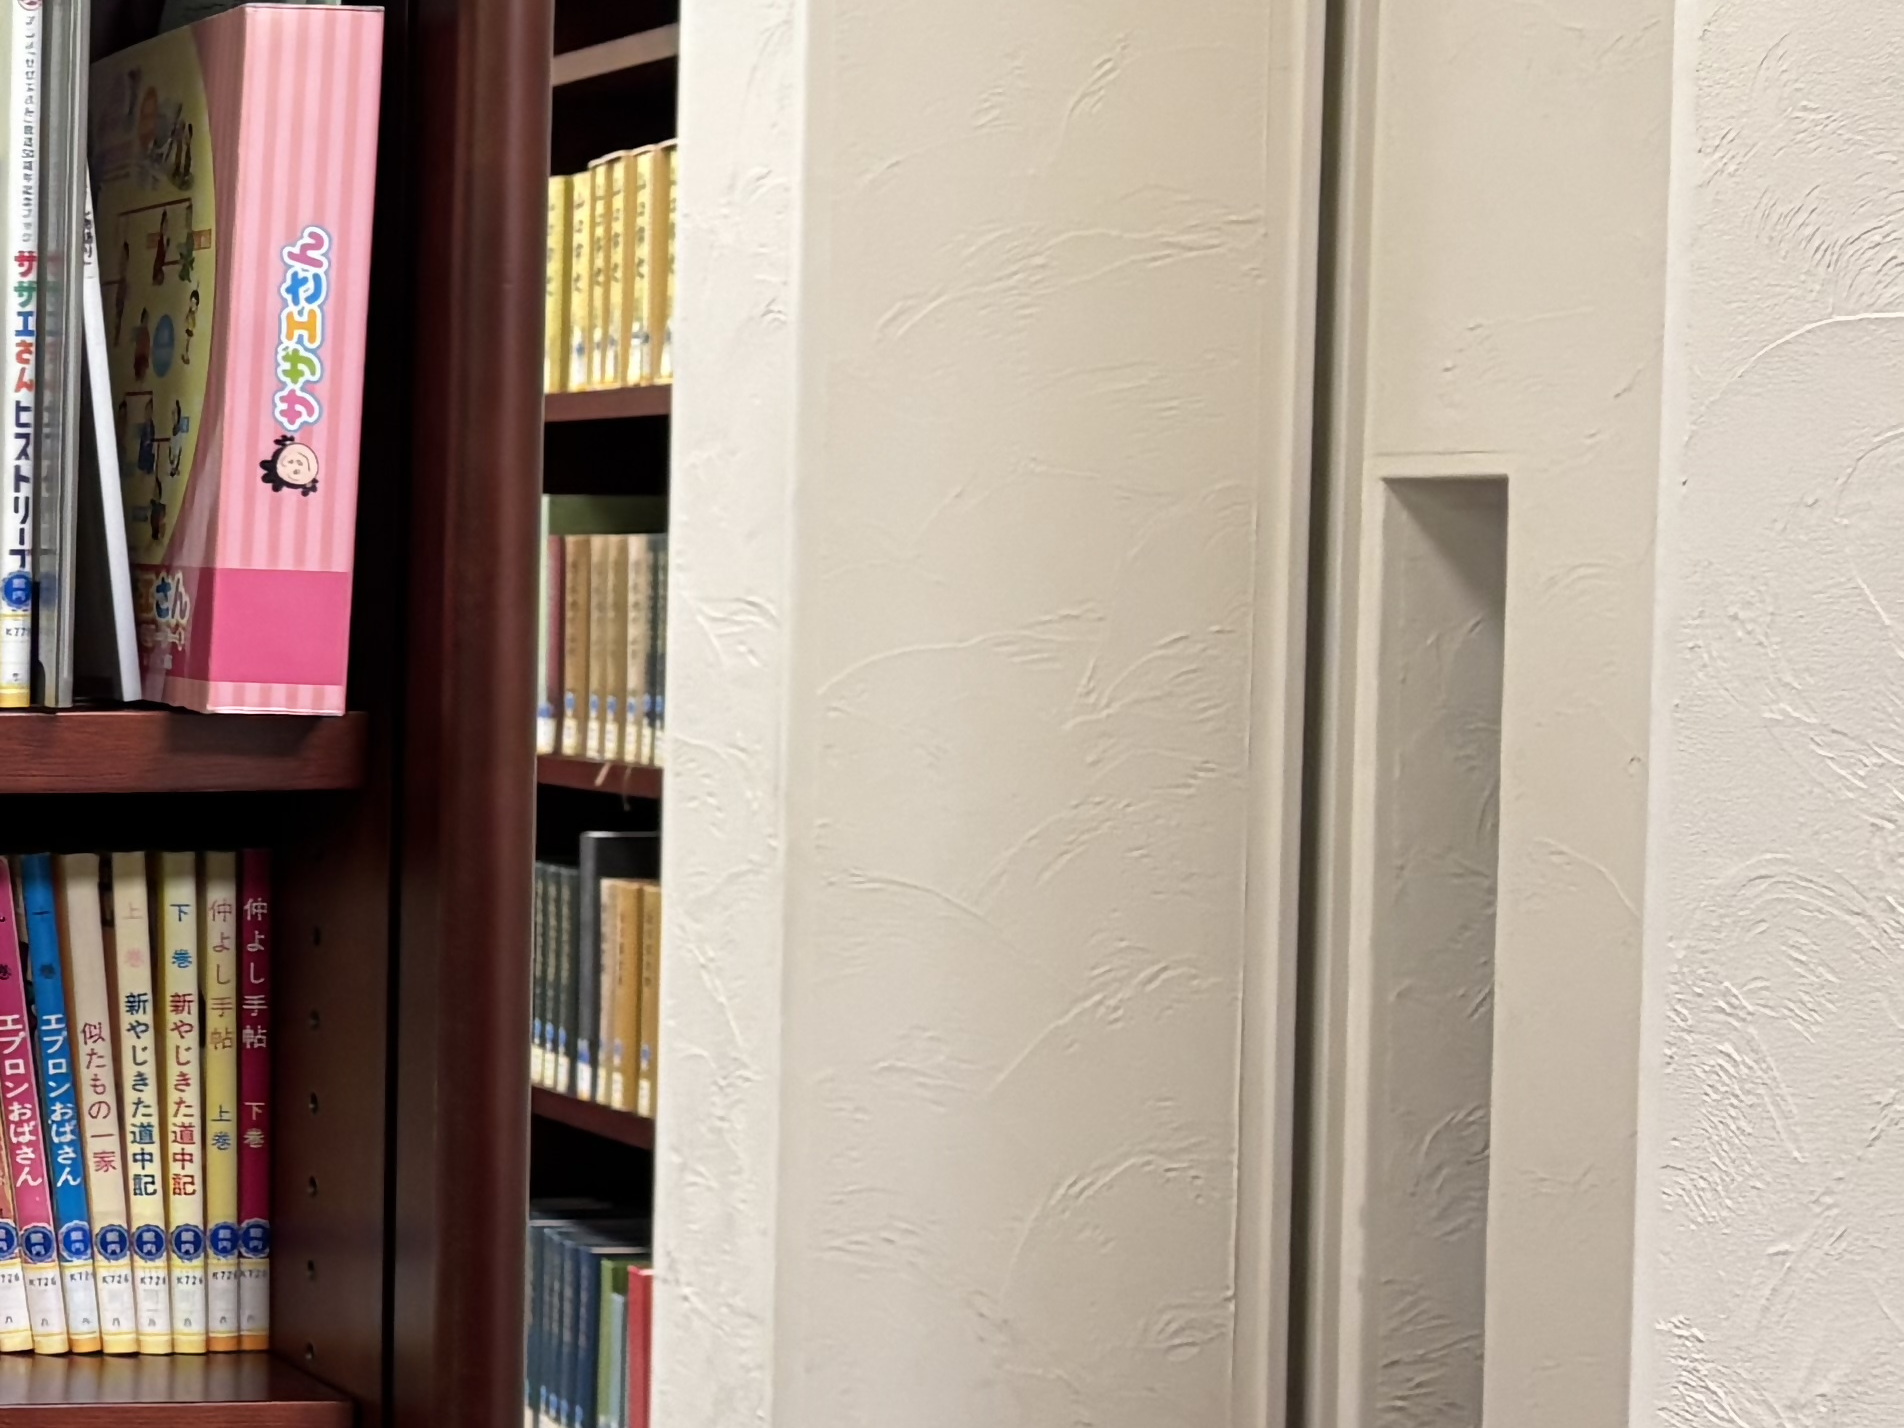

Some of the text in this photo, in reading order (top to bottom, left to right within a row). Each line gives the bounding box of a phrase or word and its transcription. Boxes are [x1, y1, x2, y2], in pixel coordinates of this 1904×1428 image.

[273, 226, 333, 432] サザエさん
[80, 1021, 117, 1172] 似たもの一家
[124, 992, 158, 1196] 新やじきた道中記
[169, 992, 197, 1196] 新やじきた道中記
[208, 898, 234, 1150] 仲よし手帖 上巻
[242, 898, 269, 1148] 仲よし手帖 下巻
